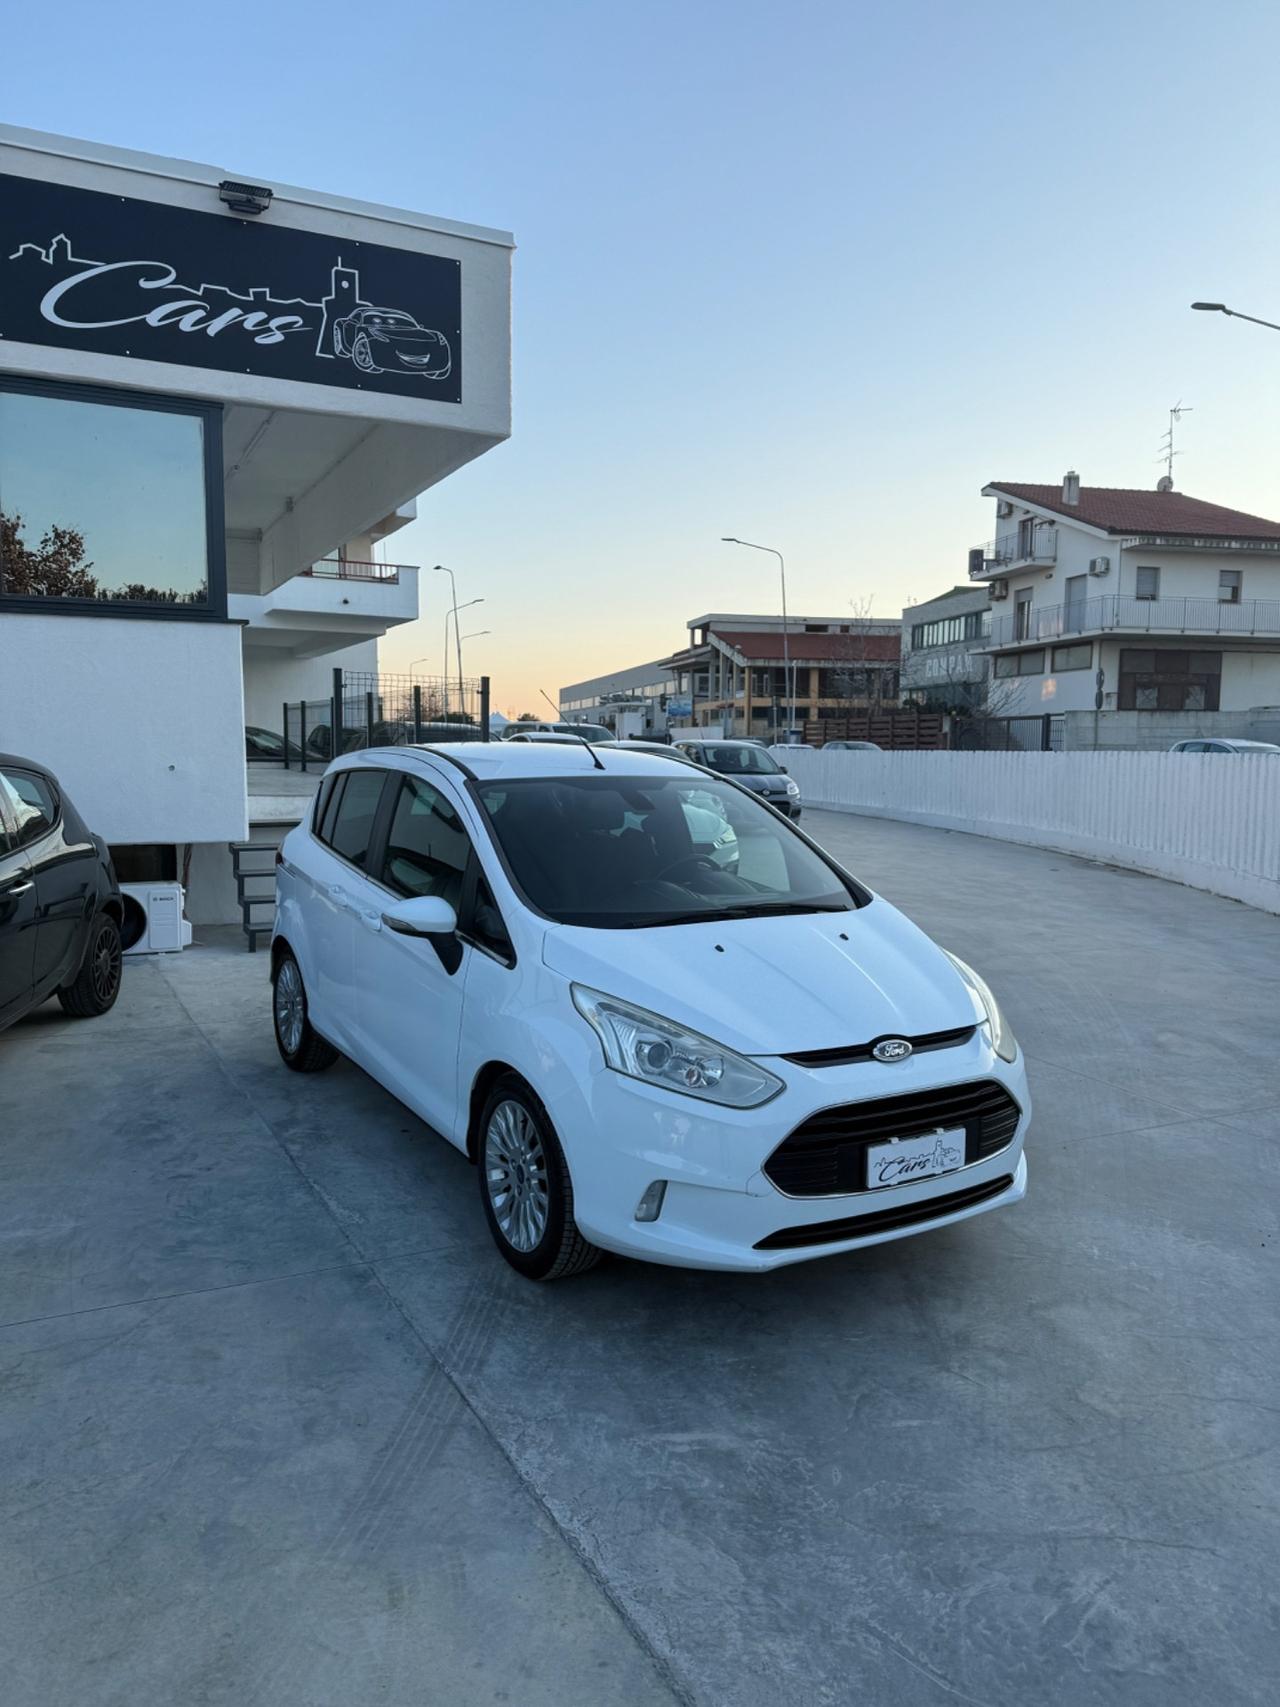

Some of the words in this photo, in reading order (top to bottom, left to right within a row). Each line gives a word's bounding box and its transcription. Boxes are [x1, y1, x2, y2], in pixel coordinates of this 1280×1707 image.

[40, 261, 313, 344] Cars
[884, 1043, 905, 1057] Ford
[879, 1156, 930, 1182] Cars
